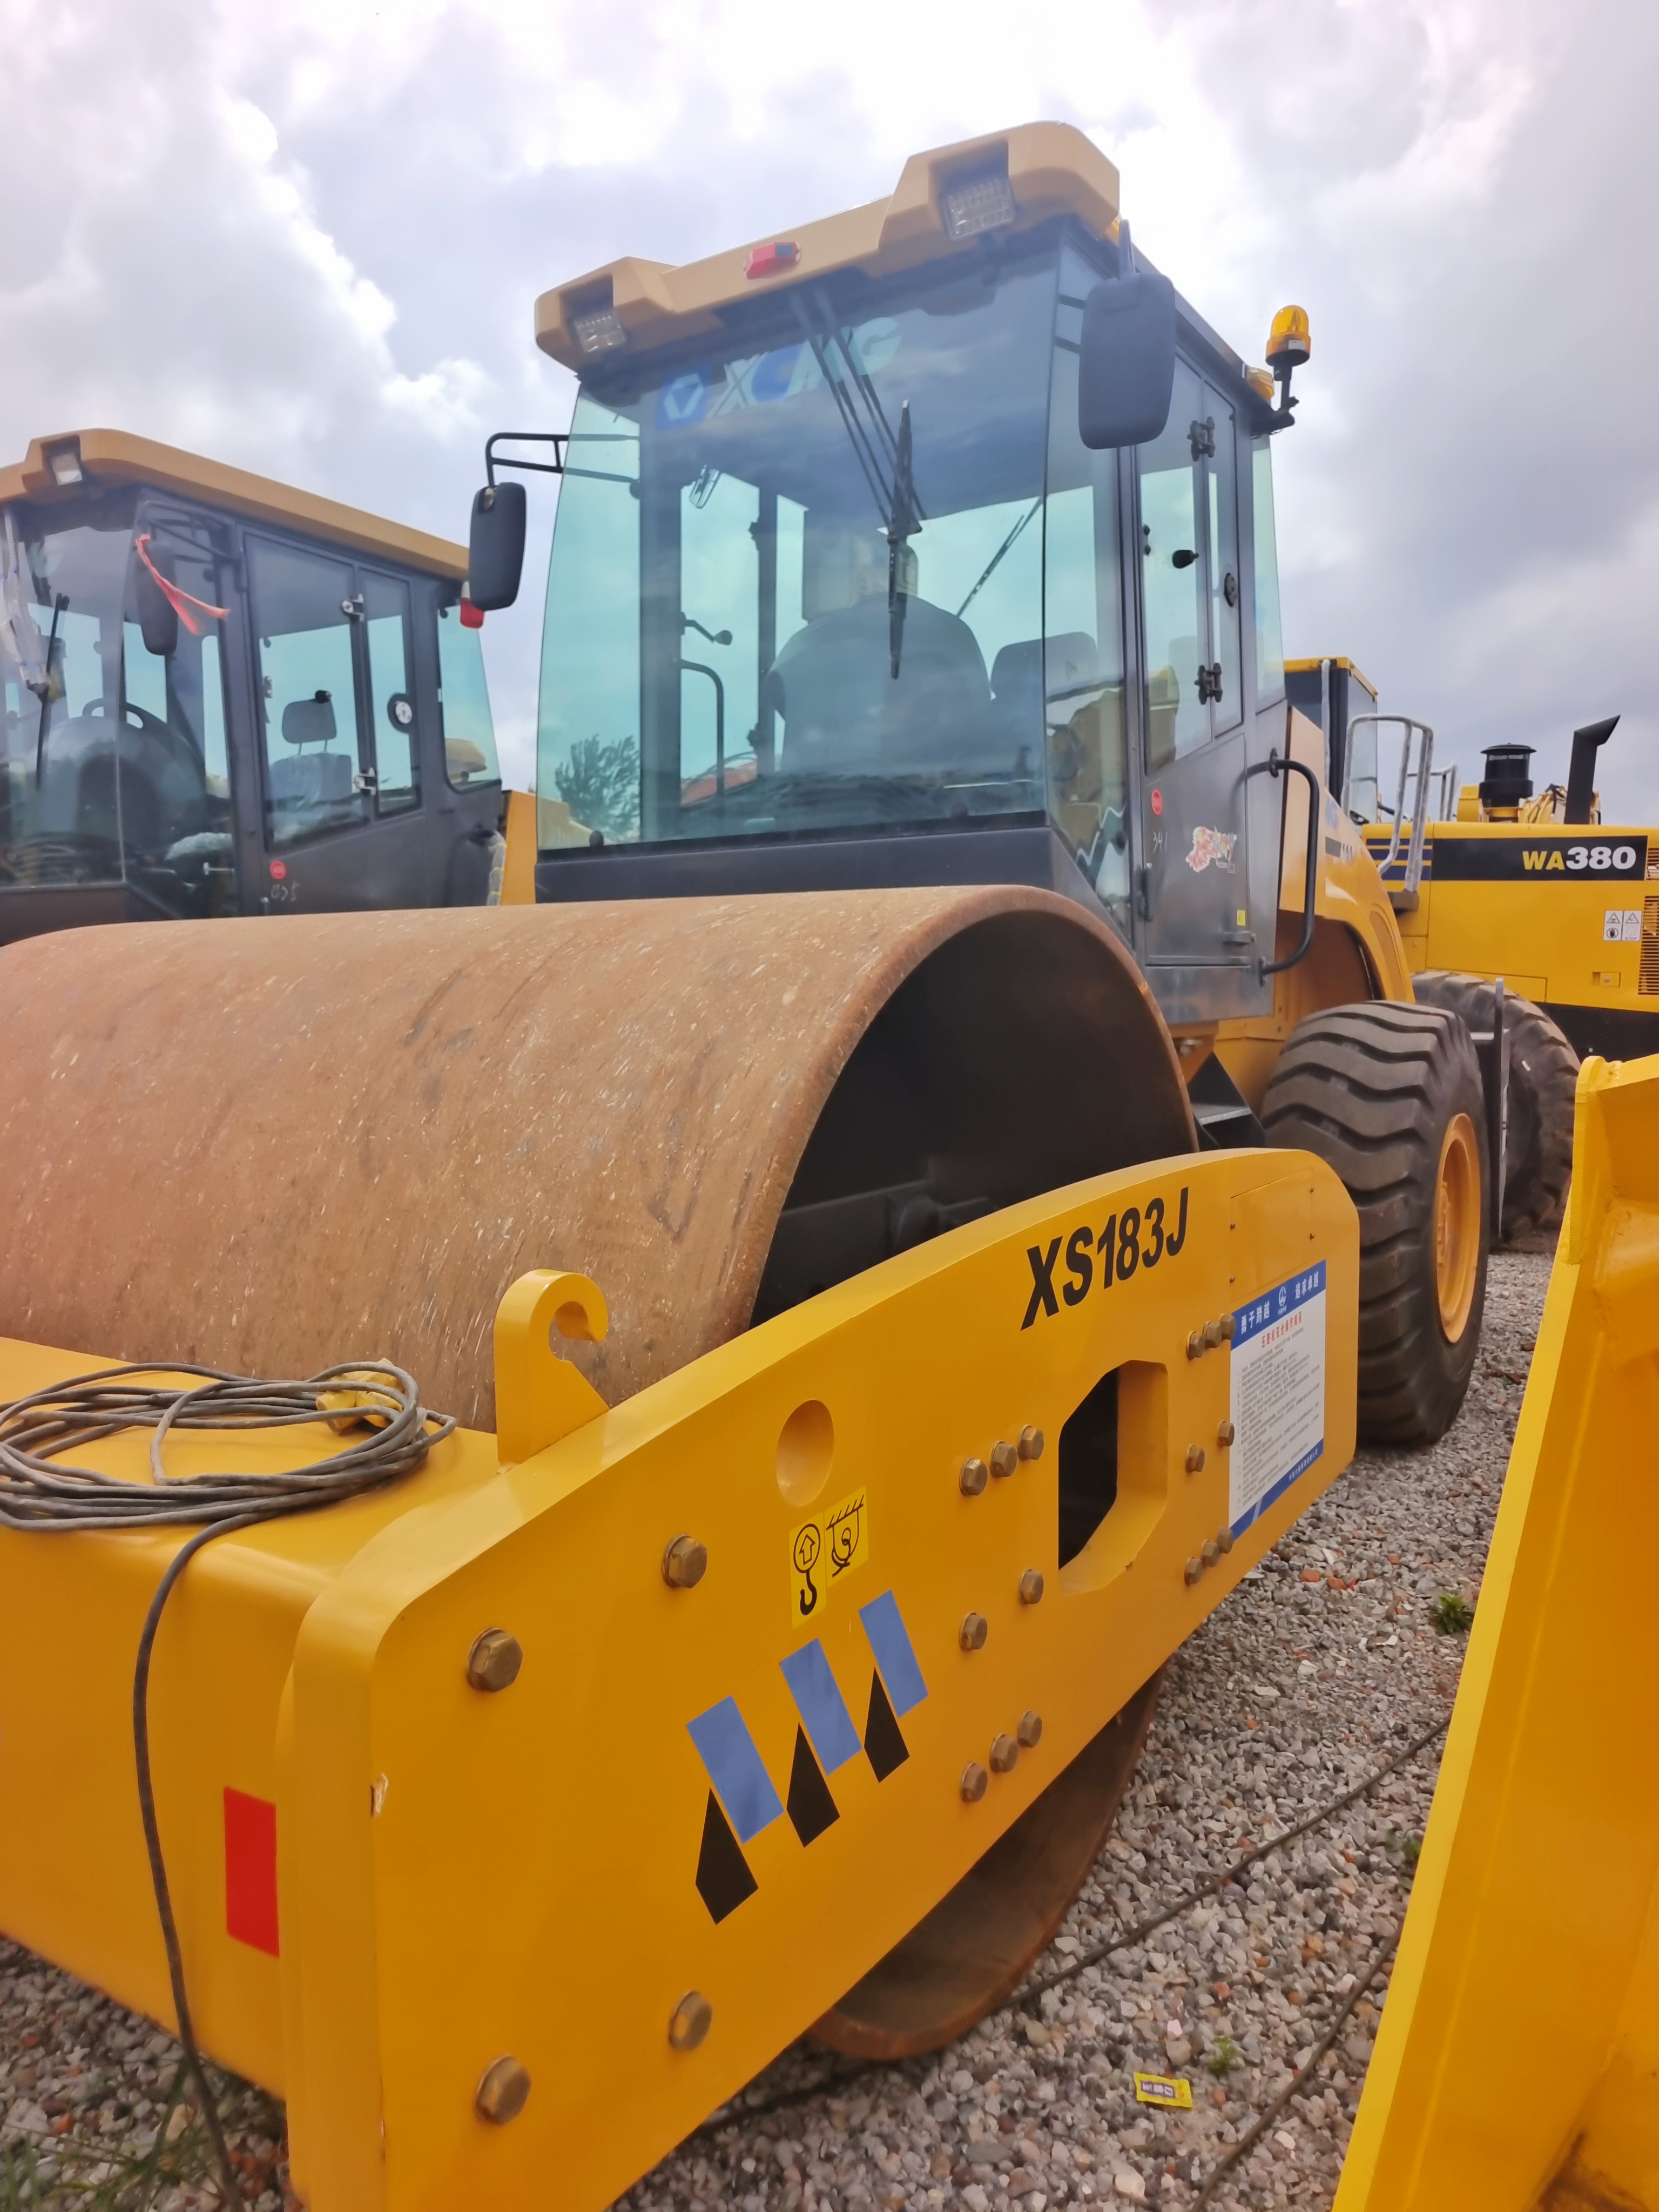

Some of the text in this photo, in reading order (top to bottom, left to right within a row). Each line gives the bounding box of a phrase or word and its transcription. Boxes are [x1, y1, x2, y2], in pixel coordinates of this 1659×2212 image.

[1020, 1186, 1189, 1331] XS183J
[1241, 1270, 1319, 1334] 勇于跨越 追求卓越
